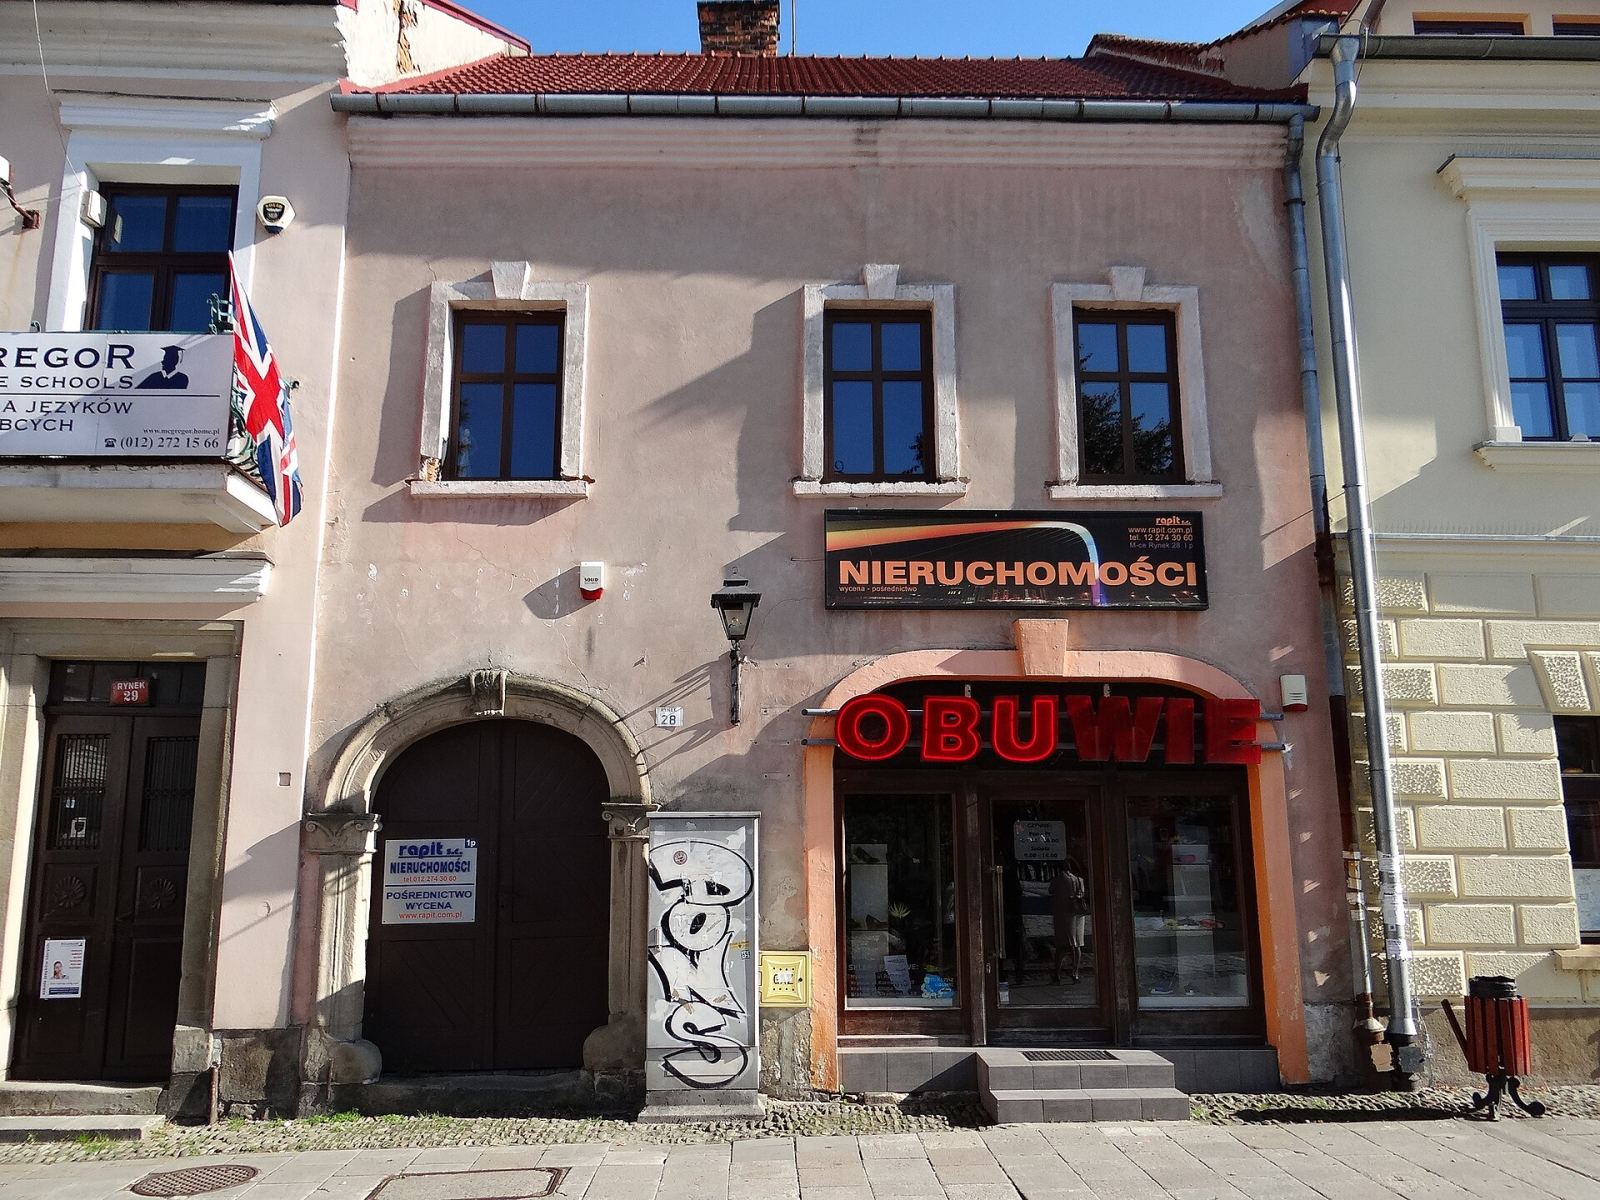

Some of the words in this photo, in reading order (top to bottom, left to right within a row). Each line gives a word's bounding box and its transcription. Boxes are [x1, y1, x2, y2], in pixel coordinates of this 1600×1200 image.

[20, 375, 134, 389] SCHOOLS
[25, 398, 133, 417] JĘZYKÓW
[120, 437, 154, 450] (012)
[158, 437, 180, 448] 272
[186, 437, 200, 448] 15
[203, 437, 219, 448] 66
[1155, 515, 1181, 526] rapit
[1148, 542, 1170, 550] Rynek
[839, 555, 1197, 586] NIERUCHOMOŚCI
[871, 585, 918, 593] pośrednictwo
[117, 681, 145, 690] RYNEK
[123, 690, 139, 702] 29
[661, 715, 676, 725] 28
[834, 693, 1261, 765] OBUWIE
[466, 839, 477, 848] 1p
[398, 842, 443, 859] rapit
[390, 858, 471, 873] NIERUCHOMOŚCI
[386, 889, 473, 900] POŚREDNICTWO
[405, 901, 452, 910] WYCENA
[398, 911, 463, 919] www.rapit.com.pl
[773, 974, 794, 985] GZ
